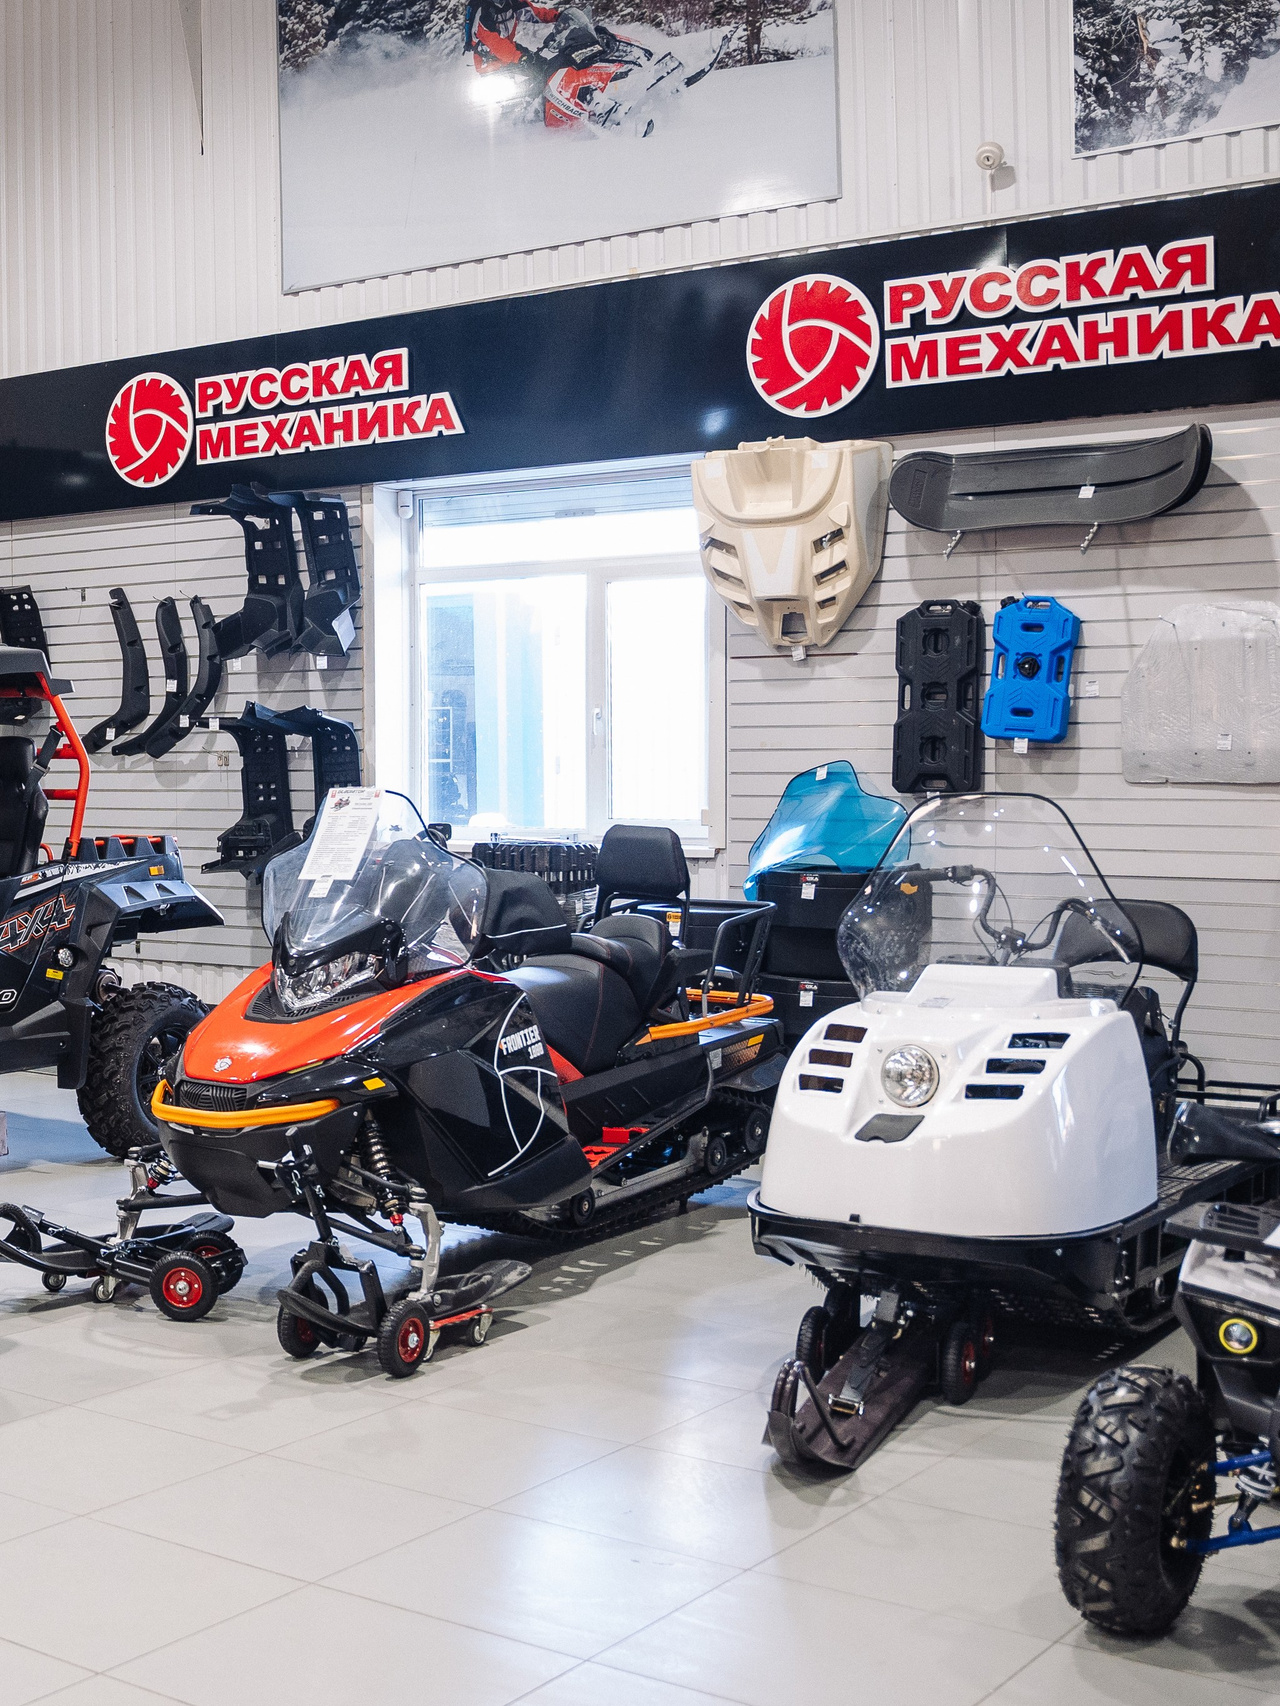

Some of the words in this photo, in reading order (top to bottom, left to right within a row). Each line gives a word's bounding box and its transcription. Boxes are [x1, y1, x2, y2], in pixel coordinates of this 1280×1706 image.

[887, 242, 1209, 326] РУССКАЯ
[888, 296, 1280, 384] МЕХАНИКА
[197, 352, 405, 415] РУССКАЯ
[198, 396, 460, 462] МЕХАНИКА
[501, 1024, 541, 1055] FRONTIER
